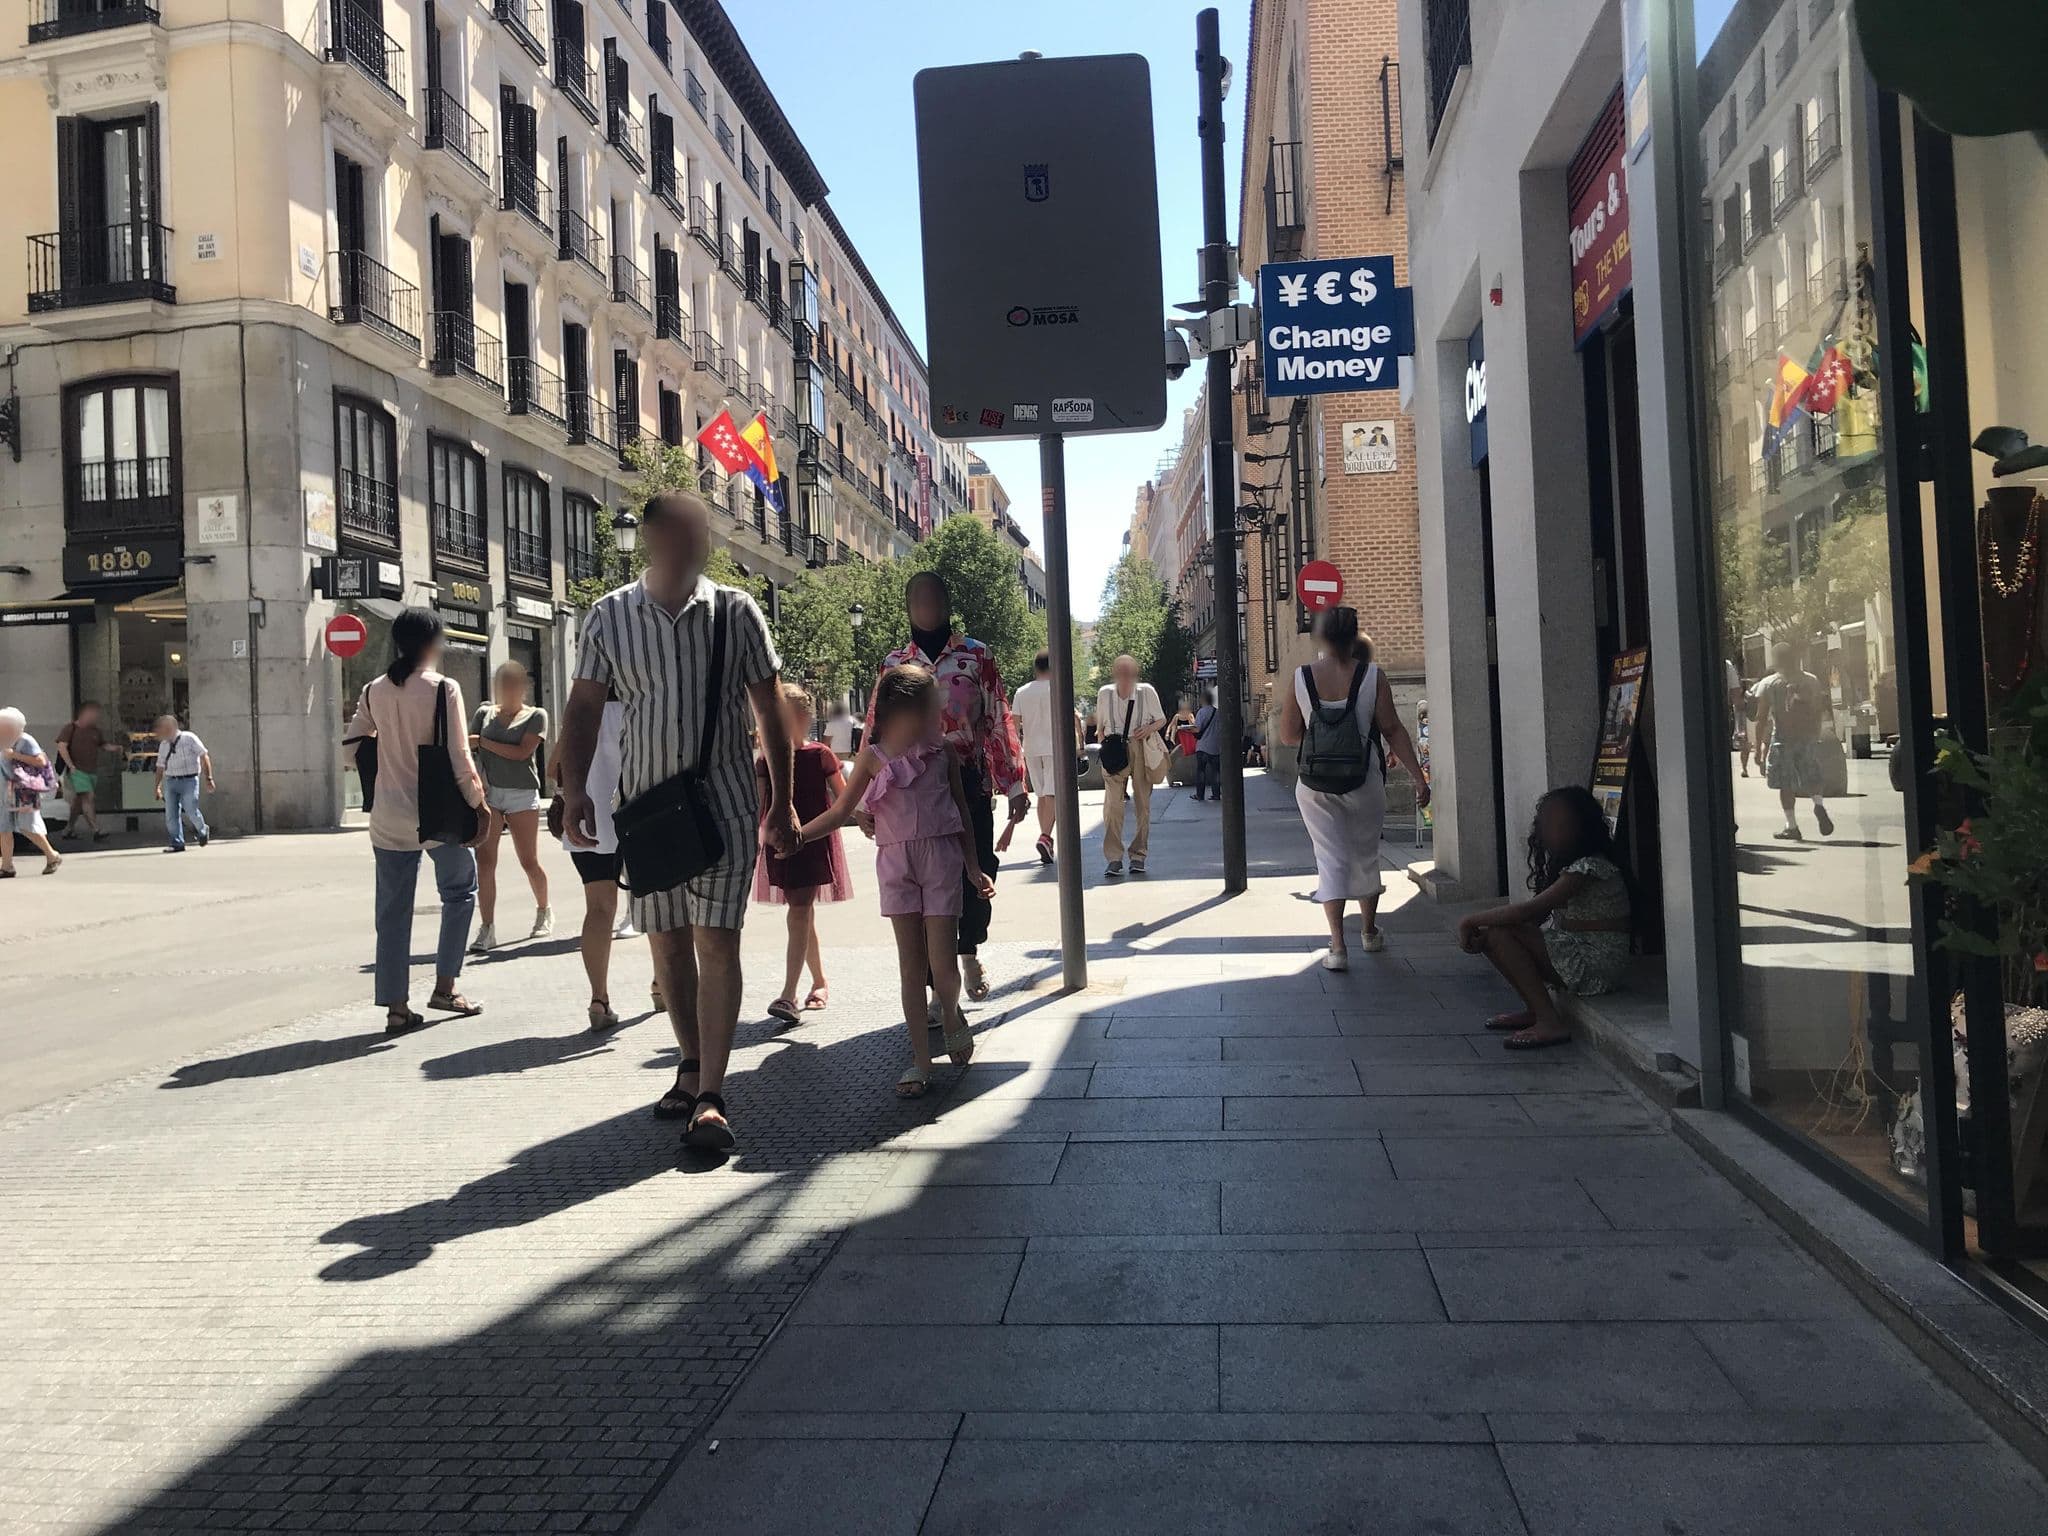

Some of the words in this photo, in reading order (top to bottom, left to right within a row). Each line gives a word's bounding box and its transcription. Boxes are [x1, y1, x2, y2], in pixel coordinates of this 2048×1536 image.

[1570, 201, 1606, 267] Tours
[1607, 172, 1620, 217] &
[1596, 245, 1613, 288] THE
[1033, 312, 1079, 326] MOSA
[1268, 324, 1392, 352] Change
[1277, 356, 1385, 382] Money
[1465, 359, 1487, 424] Cha
[1053, 400, 1092, 413] RAPSODA
[87, 550, 152, 571] 1880
